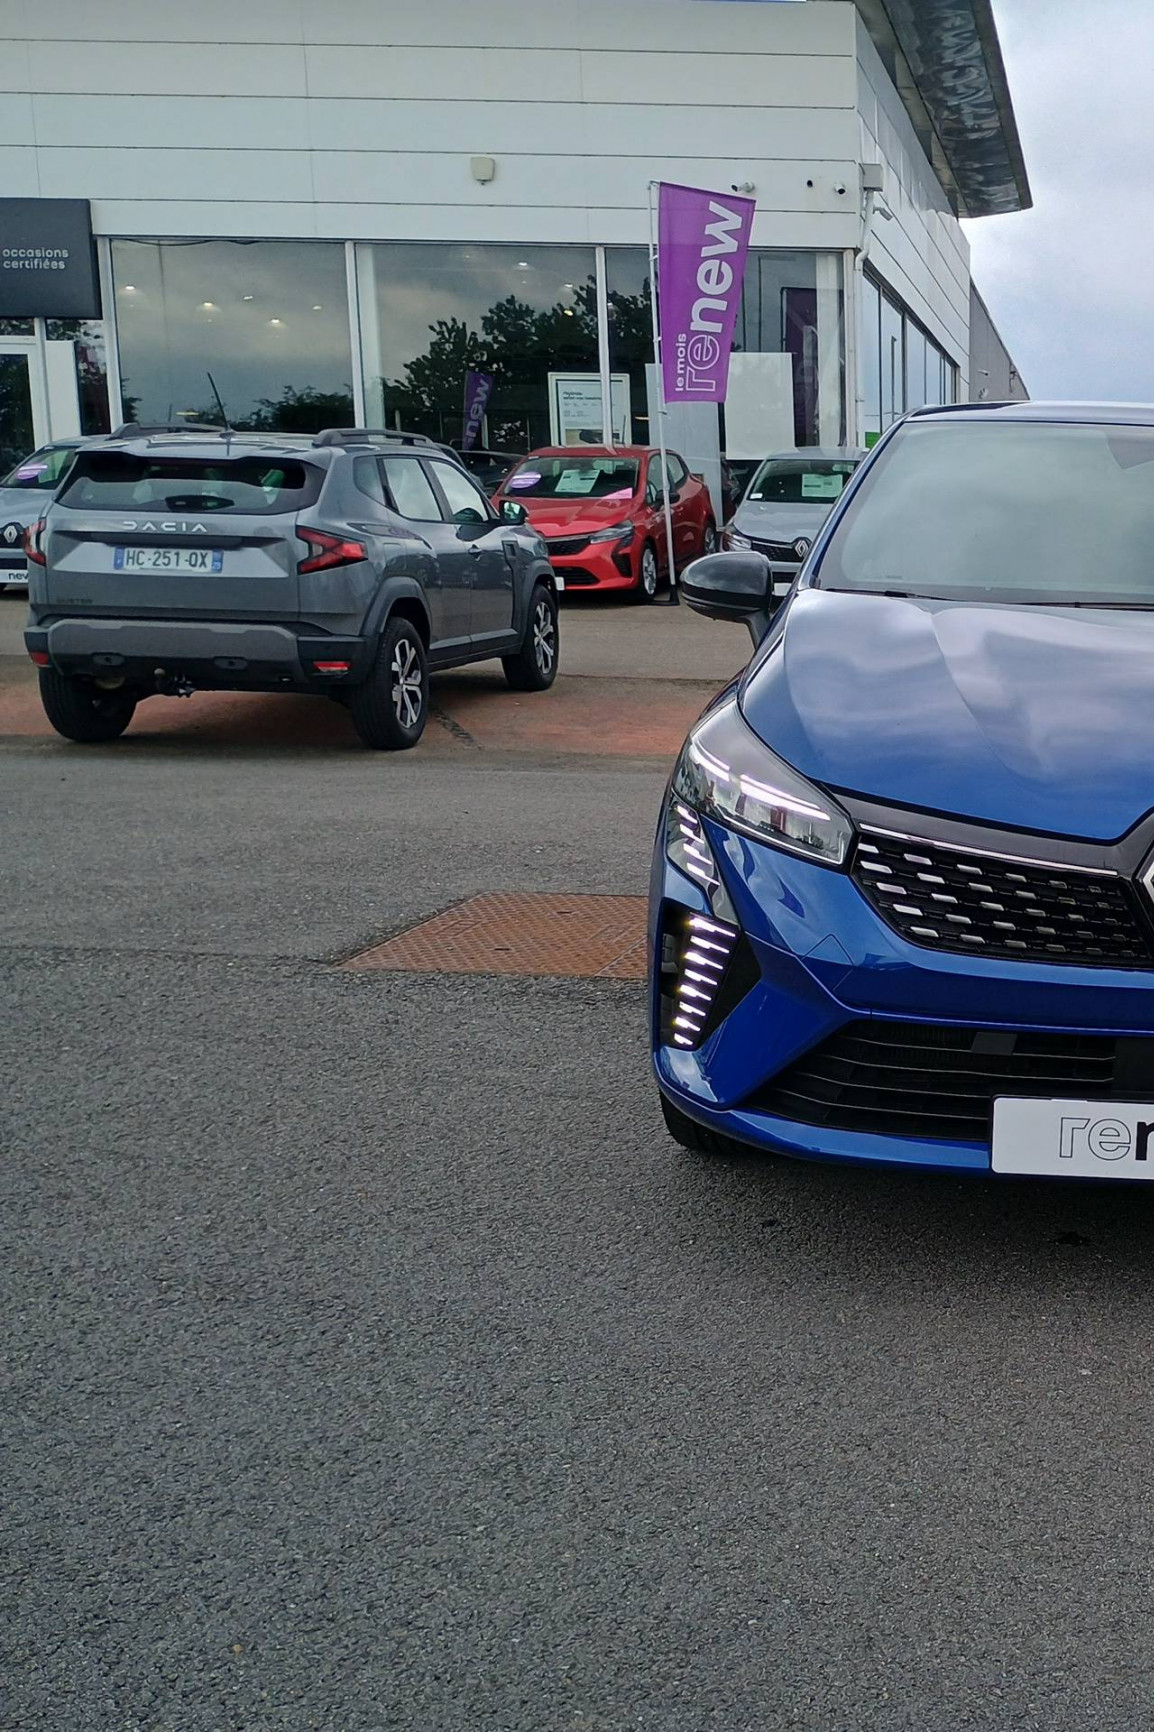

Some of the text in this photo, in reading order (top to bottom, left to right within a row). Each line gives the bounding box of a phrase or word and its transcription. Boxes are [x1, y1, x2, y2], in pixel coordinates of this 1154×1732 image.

[2, 247, 69, 258] occasions
[3, 258, 66, 269] certifiées
[686, 200, 743, 392] renew
[675, 333, 687, 392] le mois
[122, 521, 208, 533] DACIA
